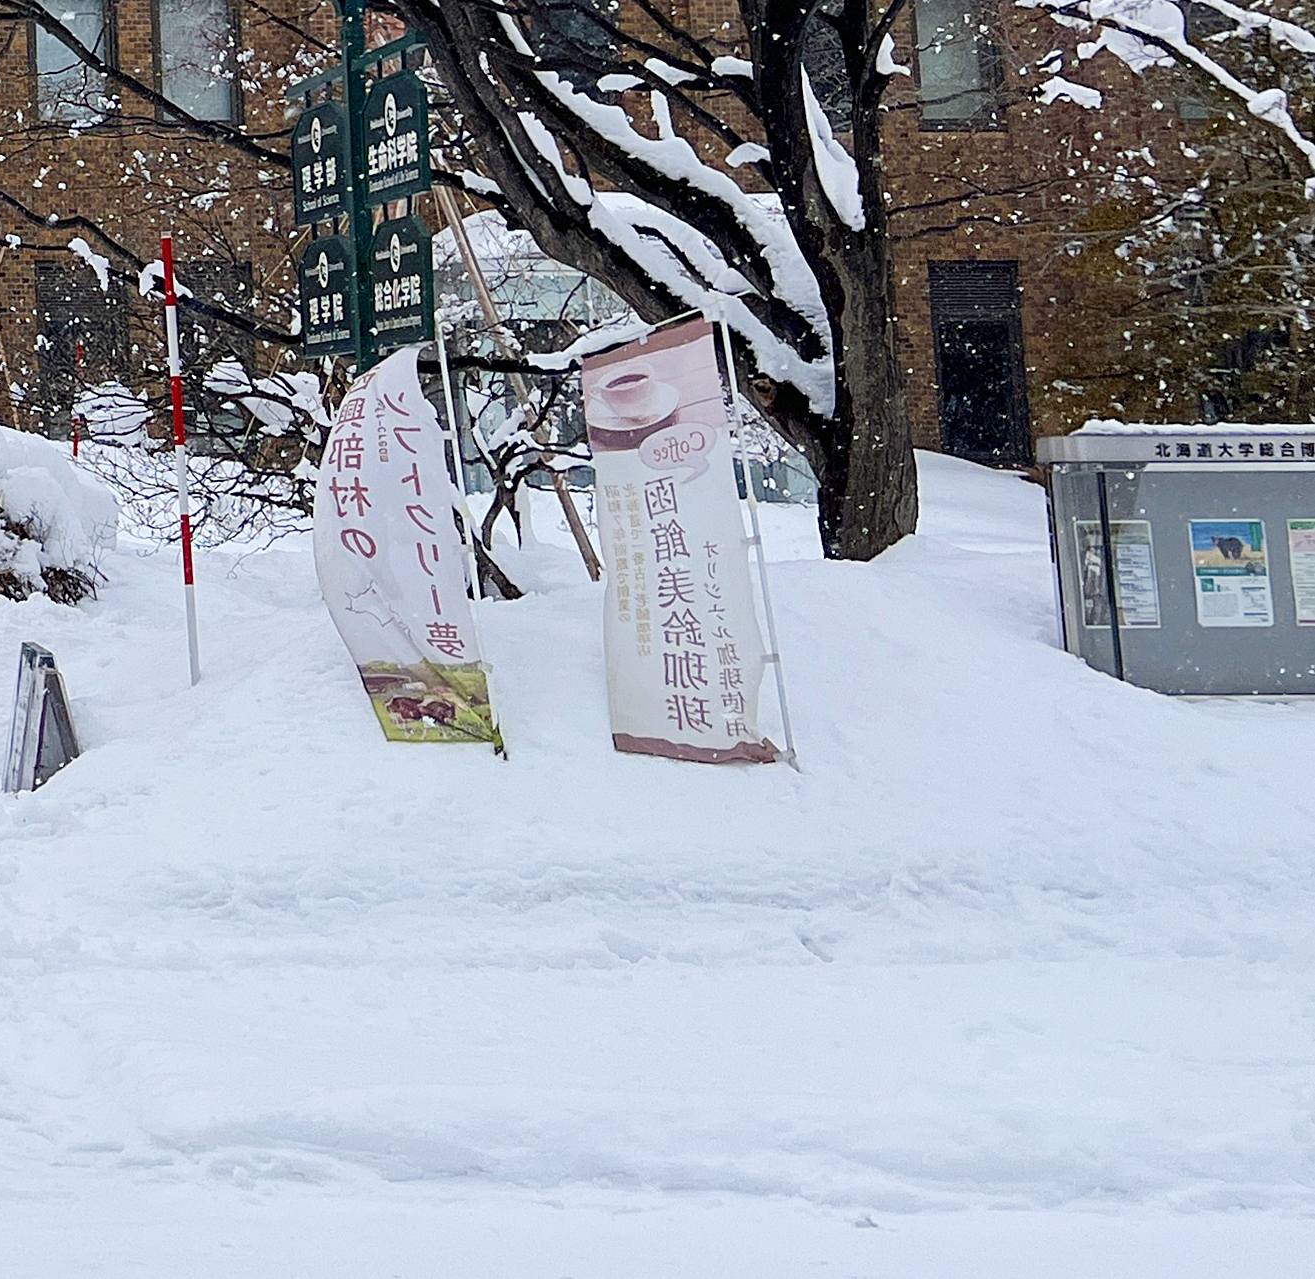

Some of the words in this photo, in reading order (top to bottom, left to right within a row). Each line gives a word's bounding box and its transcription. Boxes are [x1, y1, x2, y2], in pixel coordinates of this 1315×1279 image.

[368, 130, 419, 175] 生命科学院
[301, 157, 336, 193] 理学部
[309, 292, 344, 326] 理学院
[374, 273, 421, 312] 総合化学院
[1155, 442, 1315, 458] 北海道大学総合博
